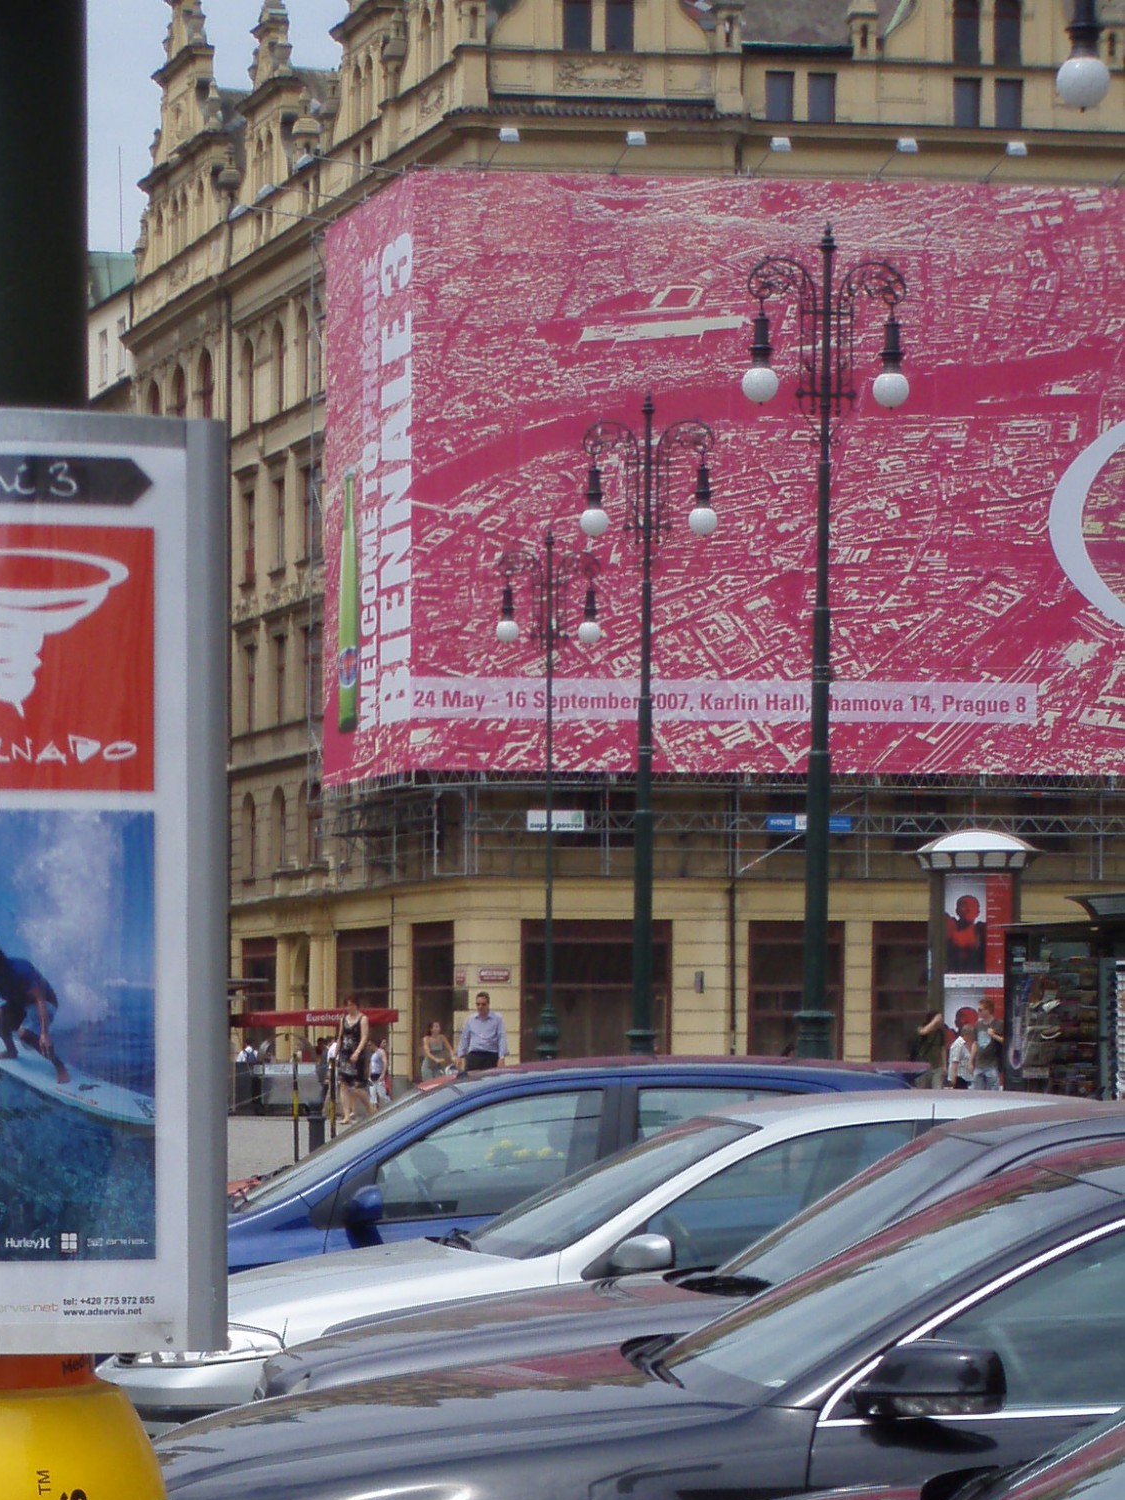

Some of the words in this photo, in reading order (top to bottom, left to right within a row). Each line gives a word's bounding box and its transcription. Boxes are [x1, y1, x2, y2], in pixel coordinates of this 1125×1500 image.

[380, 233, 413, 298] 3
[49, 462, 78, 496] 3
[361, 441, 379, 503] TO
[379, 310, 412, 726] BIENNALE
[360, 507, 378, 732] WELCOME
[413, 690, 436, 708] 24
[442, 690, 484, 712] May
[505, 691, 526, 708] 16
[700, 693, 761, 711] Karlin
[766, 693, 810, 713] Hall,
[826, 694, 903, 711] hamova
[909, 695, 936, 713] 14,
[942, 695, 1009, 717] Prague
[1015, 695, 1026, 713] 8
[306, 1012, 345, 1022] Eurohote
[5, 1237, 39, 1249] Hurley
[121, 1296, 138, 1305] 972
